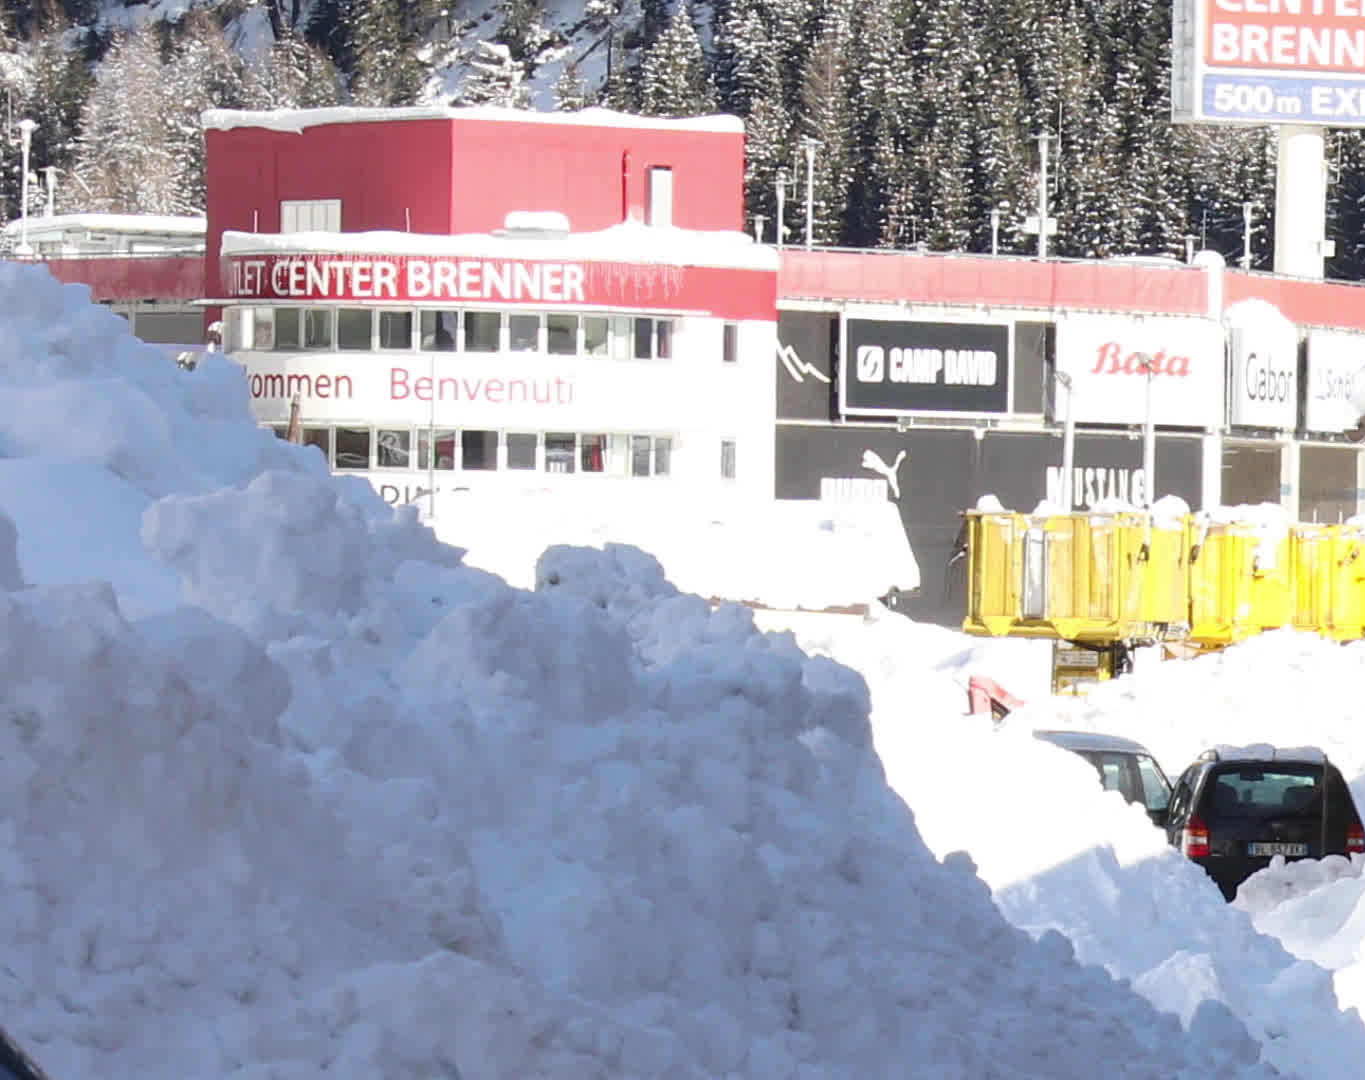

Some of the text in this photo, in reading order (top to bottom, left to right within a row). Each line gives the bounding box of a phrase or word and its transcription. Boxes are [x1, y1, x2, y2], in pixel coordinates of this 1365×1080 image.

[1213, 83, 1302, 114] 500m
[271, 260, 398, 297] CENTER
[407, 260, 585, 300] BRENNER
[889, 347, 998, 386] CAMP DAVID
[1089, 341, 1190, 377] Bata
[1246, 352, 1293, 402] Gabor
[389, 368, 573, 404] Benvenuti
[1046, 466, 1146, 508] MUSTANG
